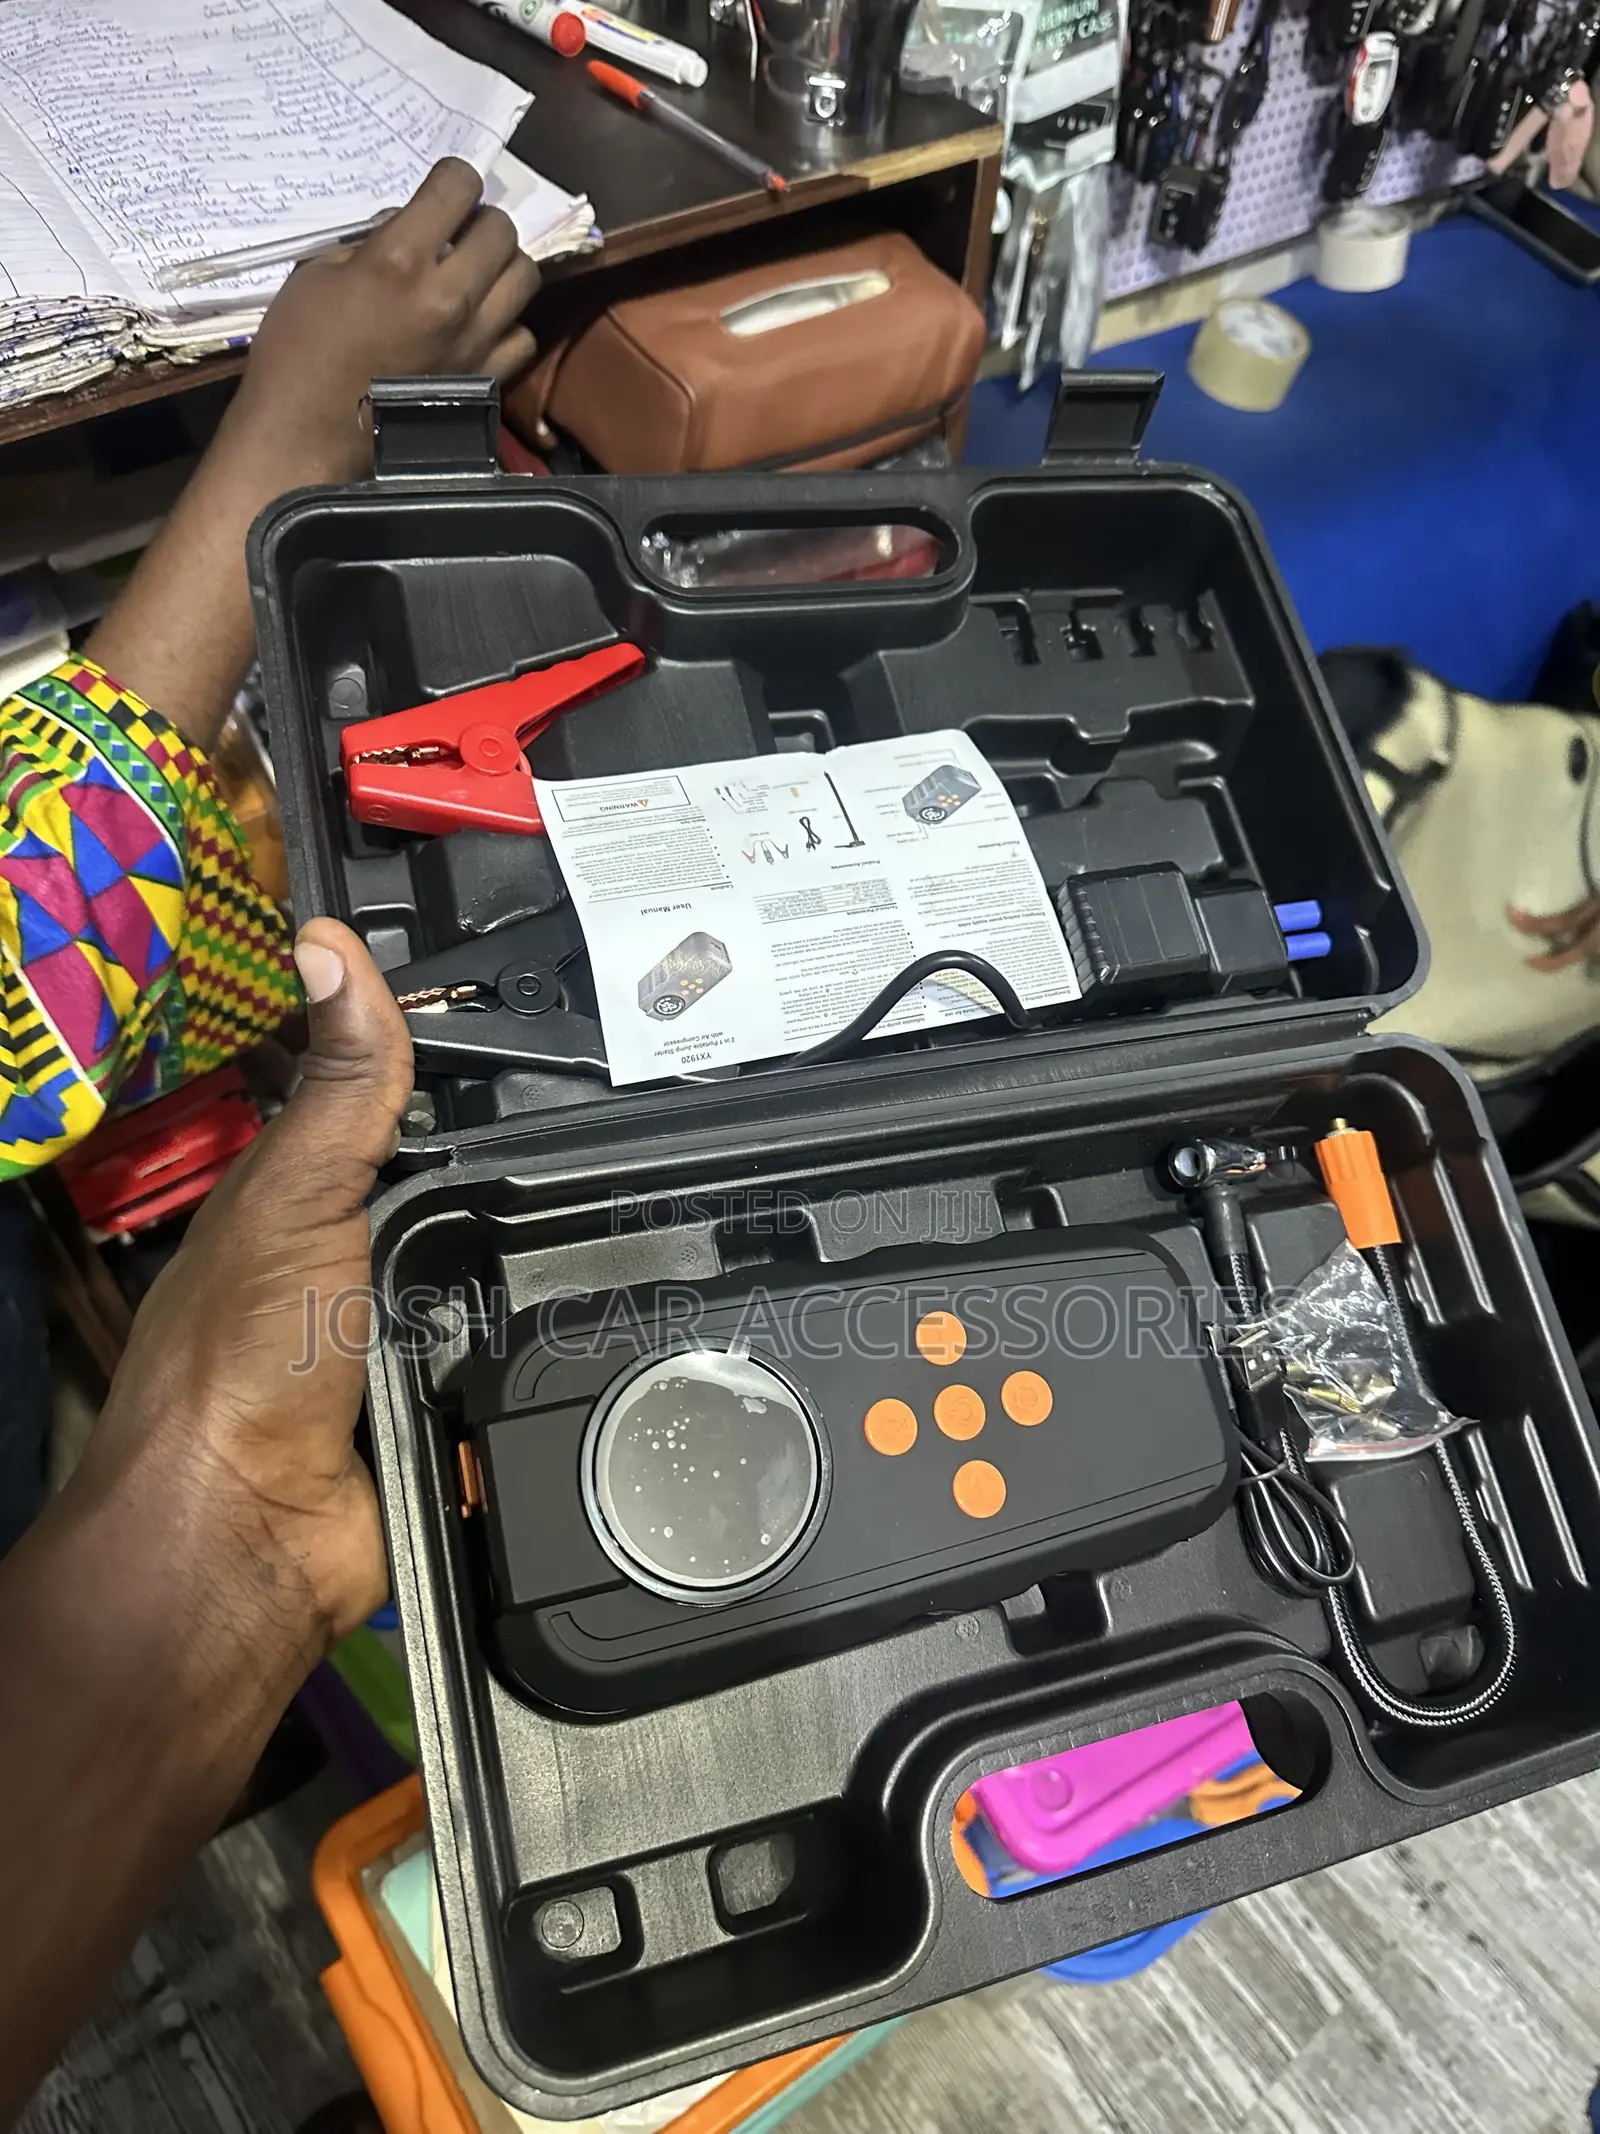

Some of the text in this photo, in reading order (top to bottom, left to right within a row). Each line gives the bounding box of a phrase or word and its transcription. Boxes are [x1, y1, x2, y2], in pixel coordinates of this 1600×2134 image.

[598, 801, 638, 812] WARNING
[639, 901, 692, 916] User Manual
[662, 1034, 700, 1047] Compressor
[710, 1031, 723, 1039] with
[674, 1043, 692, 1053] Jump
[692, 1039, 718, 1050] Portable
[653, 1047, 674, 1057] Starter
[680, 1051, 712, 1064] YX1920
